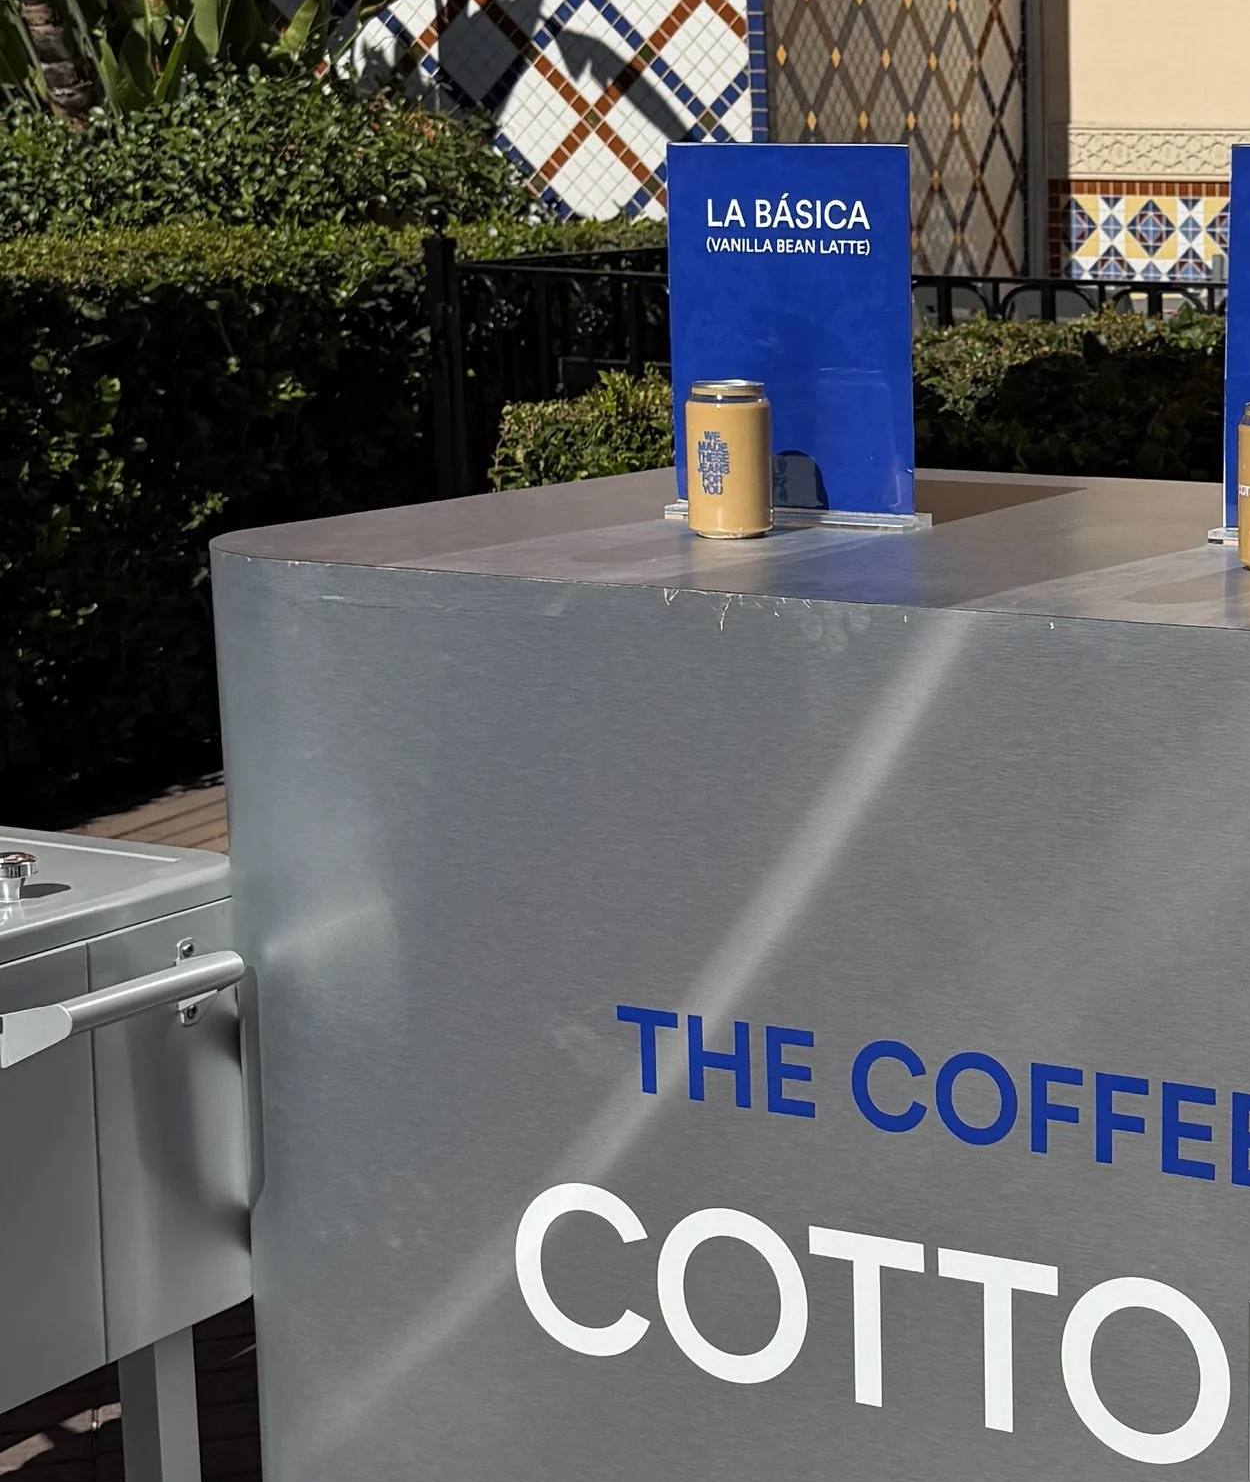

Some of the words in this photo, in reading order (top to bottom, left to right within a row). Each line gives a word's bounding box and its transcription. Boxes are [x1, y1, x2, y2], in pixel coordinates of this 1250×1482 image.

[708, 198, 746, 228] LA
[755, 192, 871, 230] BÁSICA
[706, 236, 773, 253] (VANILLA
[776, 238, 816, 254] BEAN
[819, 239, 871, 256] LATTE)
[616, 1004, 816, 1119] THE
